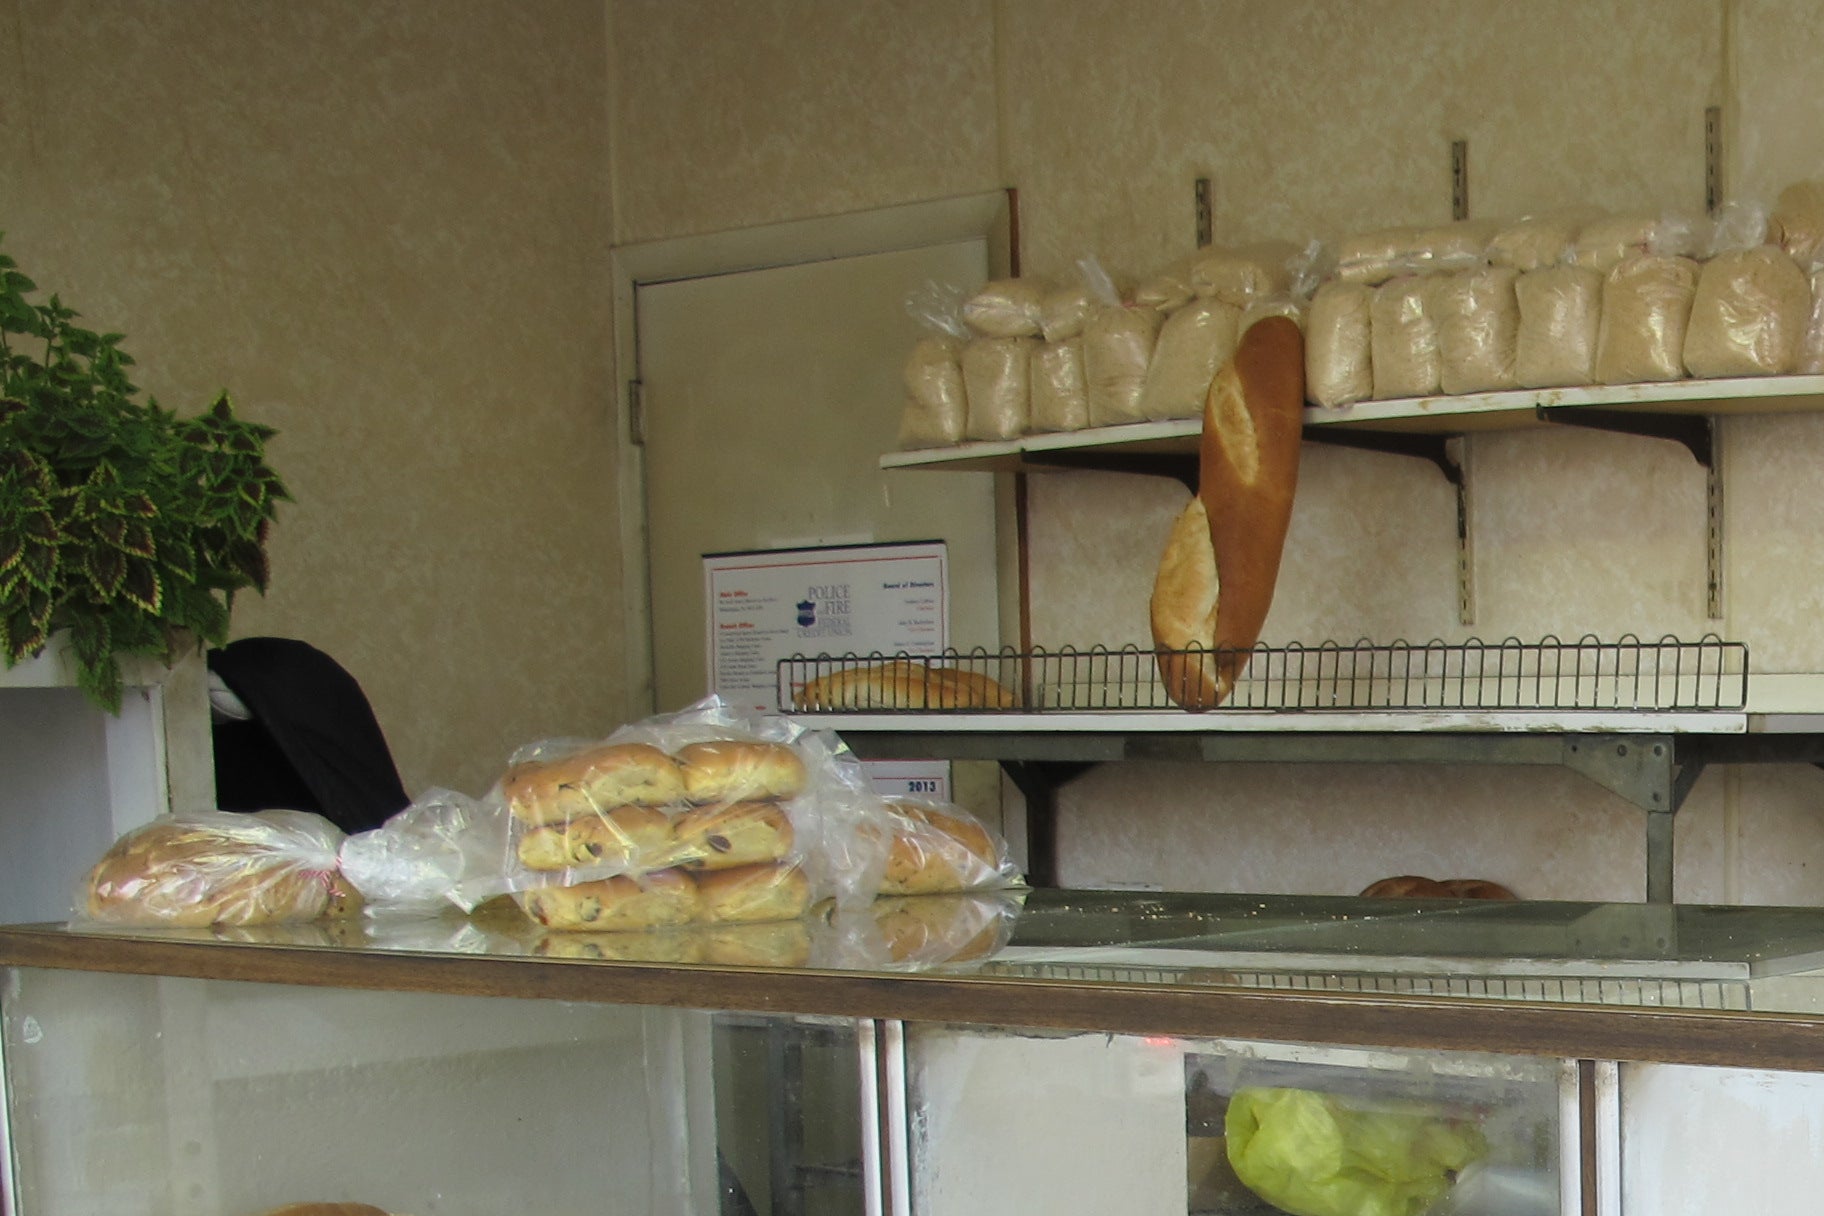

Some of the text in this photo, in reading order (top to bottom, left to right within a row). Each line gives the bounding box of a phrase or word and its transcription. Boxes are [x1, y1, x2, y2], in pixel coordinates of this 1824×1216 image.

[808, 584, 851, 600] POLICE
[824, 600, 852, 615] FIRE
[908, 781, 936, 792] 2013
